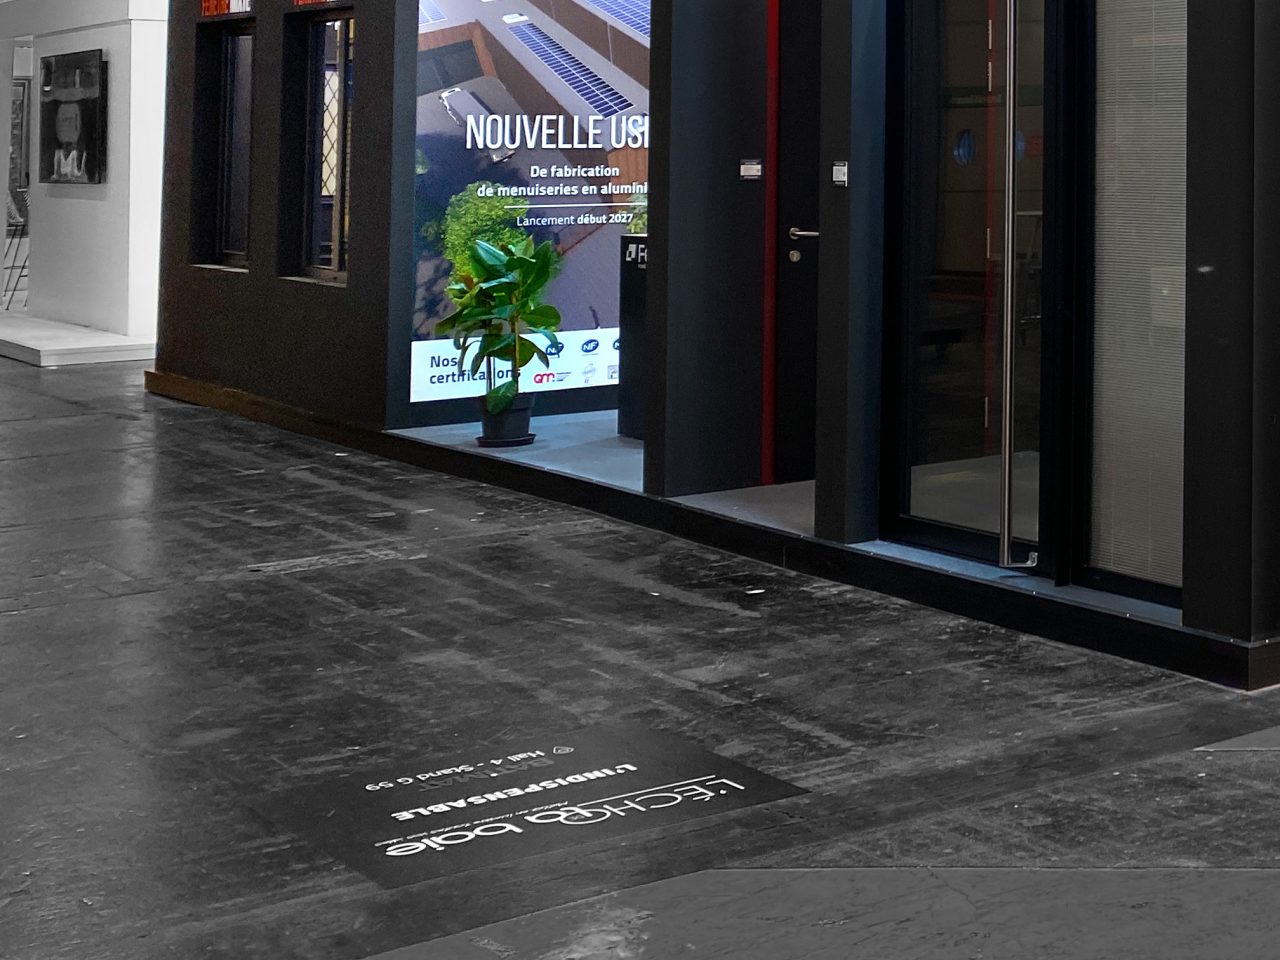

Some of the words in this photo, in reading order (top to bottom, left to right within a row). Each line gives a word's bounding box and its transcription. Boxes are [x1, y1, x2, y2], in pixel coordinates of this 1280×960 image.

[466, 114, 603, 150] NOUVELLE
[530, 165, 547, 178] De
[550, 165, 620, 178] fabrication
[477, 184, 495, 197] de
[497, 183, 579, 197] menuiseries
[581, 185, 599, 196] en
[516, 216, 575, 227] Lancement
[577, 213, 607, 225] début
[609, 213, 634, 224] 2027
[430, 355, 458, 368] Nos
[489, 758, 503, 766] 4
[507, 750, 546, 763] Hall
[415, 763, 475, 781] Stand
[365, 780, 394, 791] 59
[395, 777, 414, 785] G
[391, 764, 638, 821] L'INDISPENSABLE
[385, 823, 524, 856] baie
